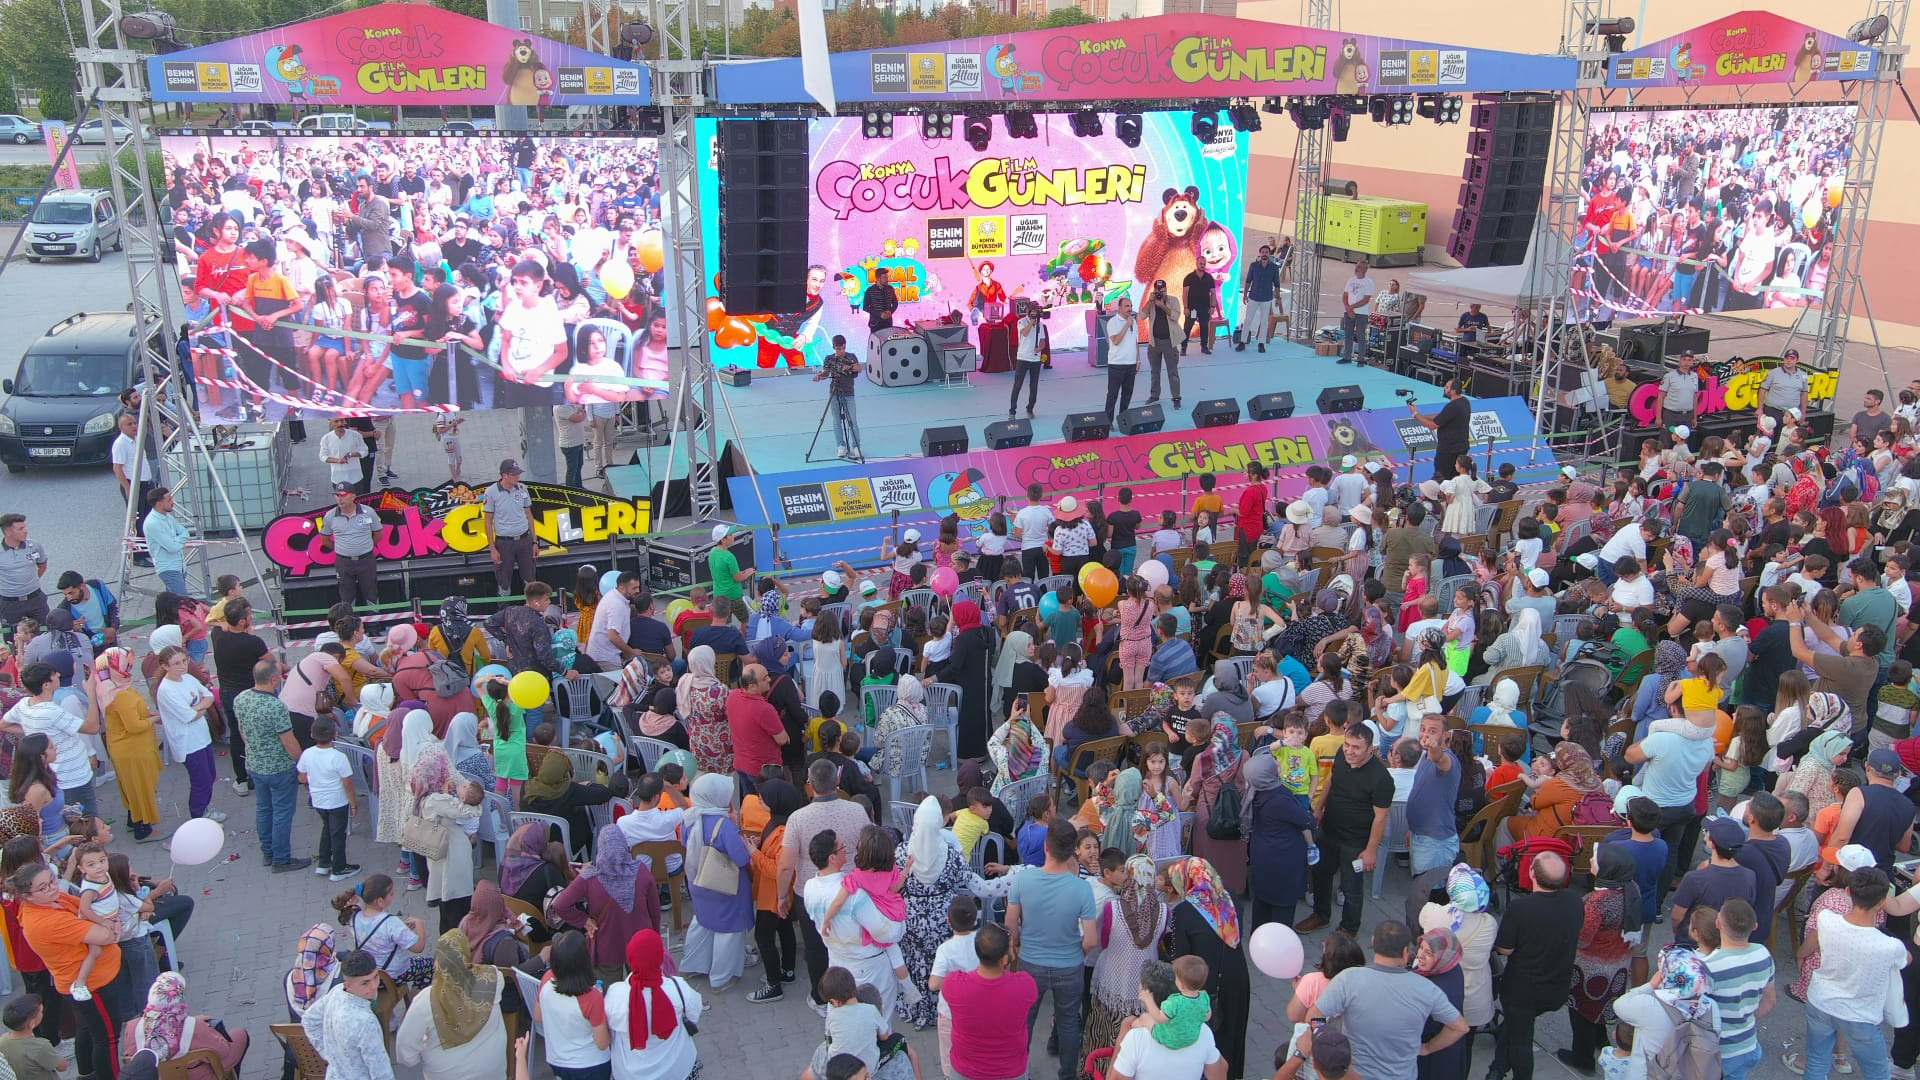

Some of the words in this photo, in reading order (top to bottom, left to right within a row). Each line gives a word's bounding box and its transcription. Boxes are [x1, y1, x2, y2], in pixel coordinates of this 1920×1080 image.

[364, 27, 402, 40] KONYA
[1079, 37, 1127, 55] KONYA
[1200, 36, 1233, 50] FİLM
[1171, 36, 1328, 83] GÜNLERİ
[874, 63, 905, 73] BENİM
[875, 74, 905, 84] ŞEHRİM
[859, 160, 916, 181] KONYA
[1000, 156, 1038, 173] FİLM
[966, 157, 1147, 209] GÜNLERİ
[930, 227, 962, 239] BENİM
[930, 239, 963, 250] ŞEHRİM
[1051, 452, 1100, 470] KONYA
[784, 492, 823, 506] BENİM
[787, 504, 826, 516] ŞEHRİM
[1015, 594, 1036, 610] 10
